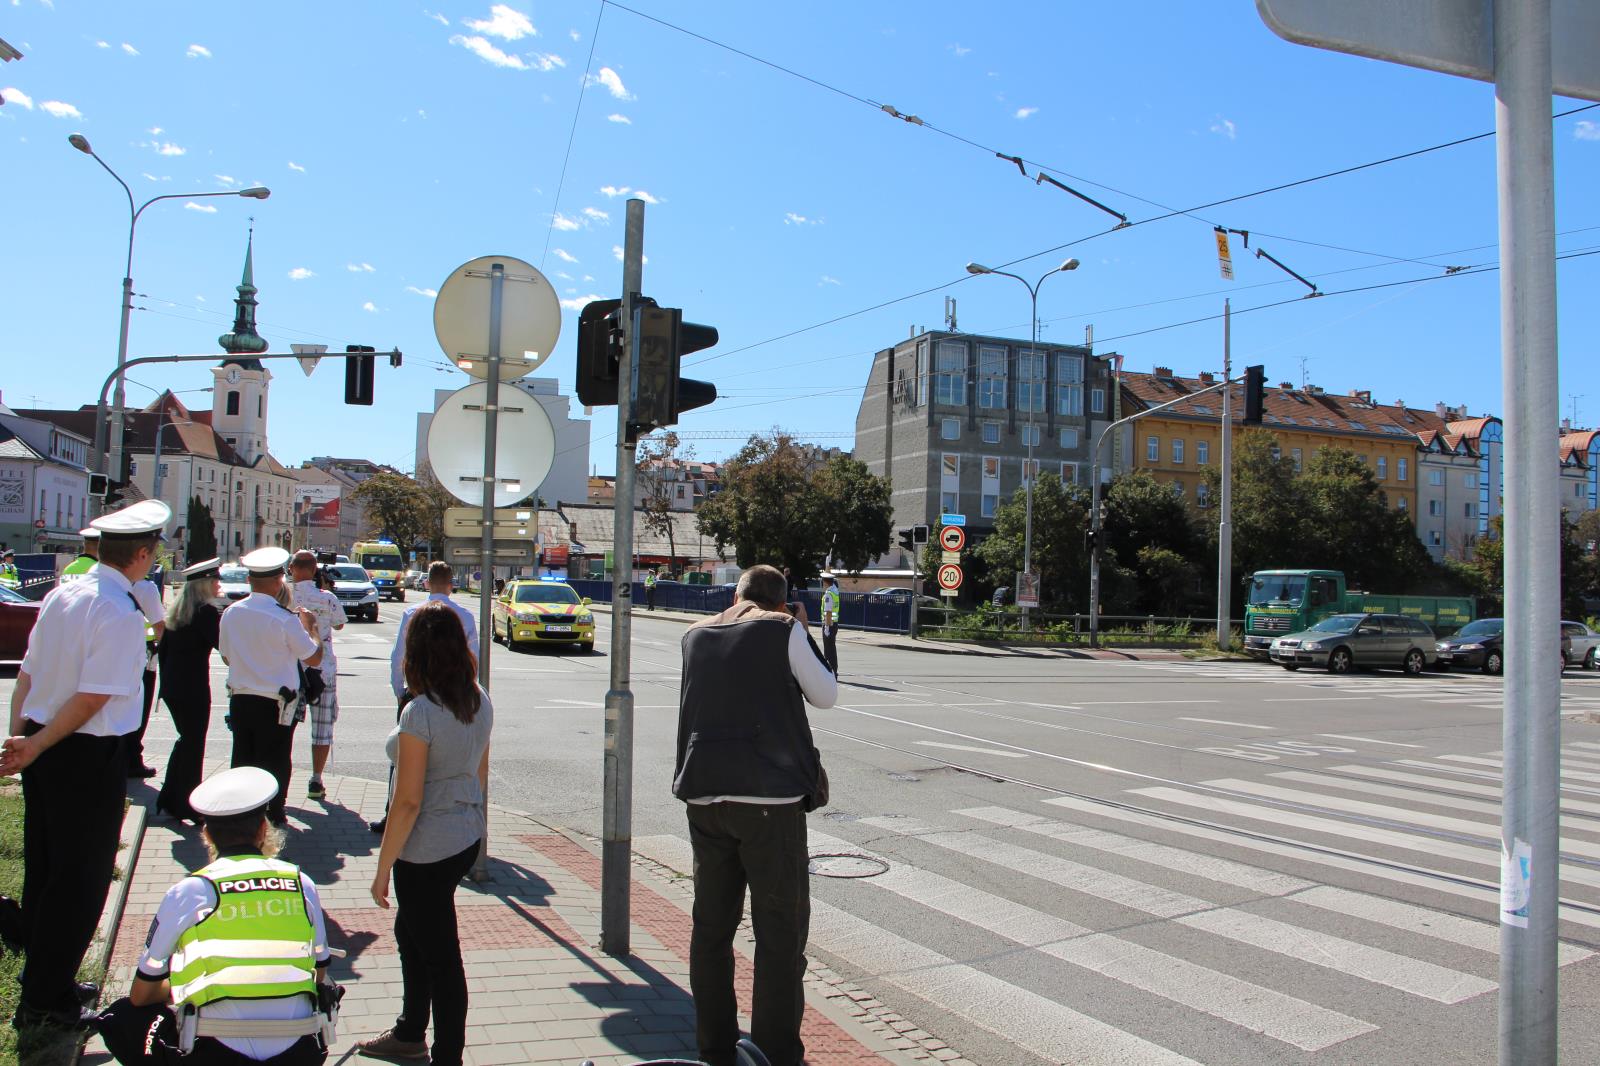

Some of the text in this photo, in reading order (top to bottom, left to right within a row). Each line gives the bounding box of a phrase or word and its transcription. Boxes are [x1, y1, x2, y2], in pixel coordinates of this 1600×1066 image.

[618, 582, 631, 598] 2
[220, 878, 297, 893] POLICIE
[144, 1014, 165, 1055] POLICIE
